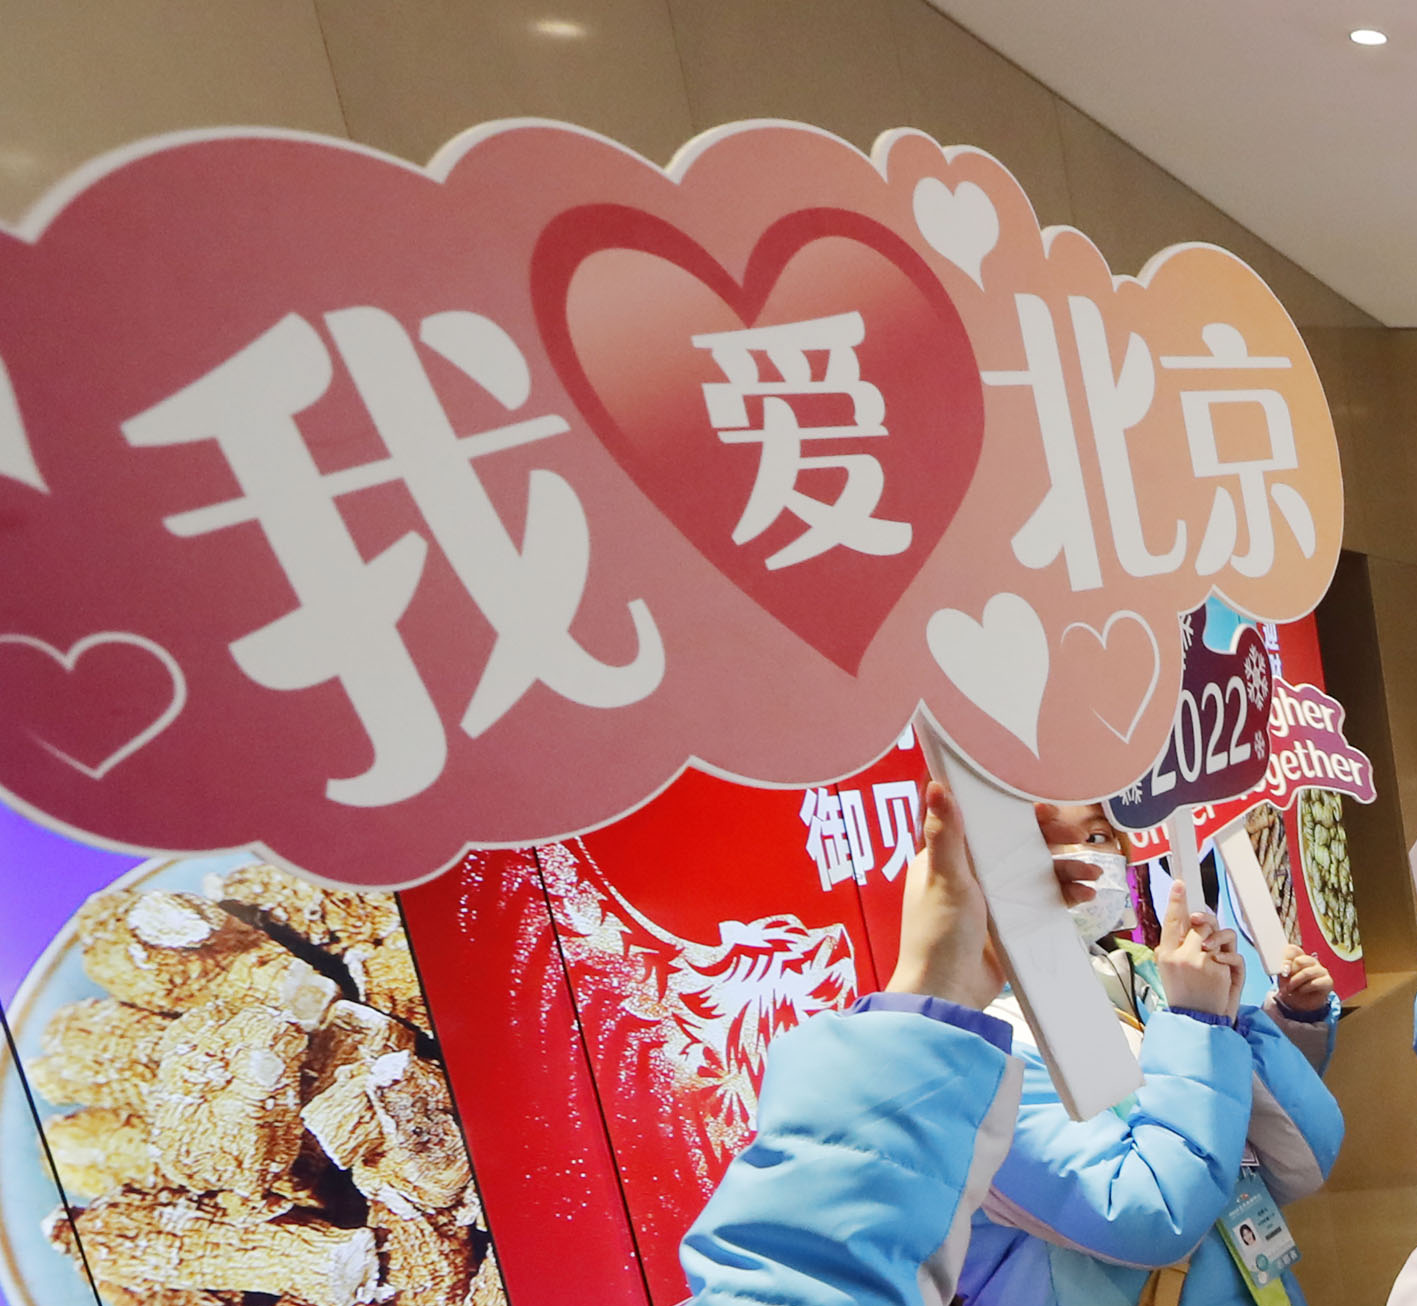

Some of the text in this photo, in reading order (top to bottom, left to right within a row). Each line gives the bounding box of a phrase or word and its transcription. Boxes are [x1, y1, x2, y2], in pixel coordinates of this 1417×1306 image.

[121, 290, 1317, 808] 我爱北京
[1269, 686, 1336, 738] gher
[1254, 739, 1364, 797] gether
[799, 780, 921, 893] 御见
